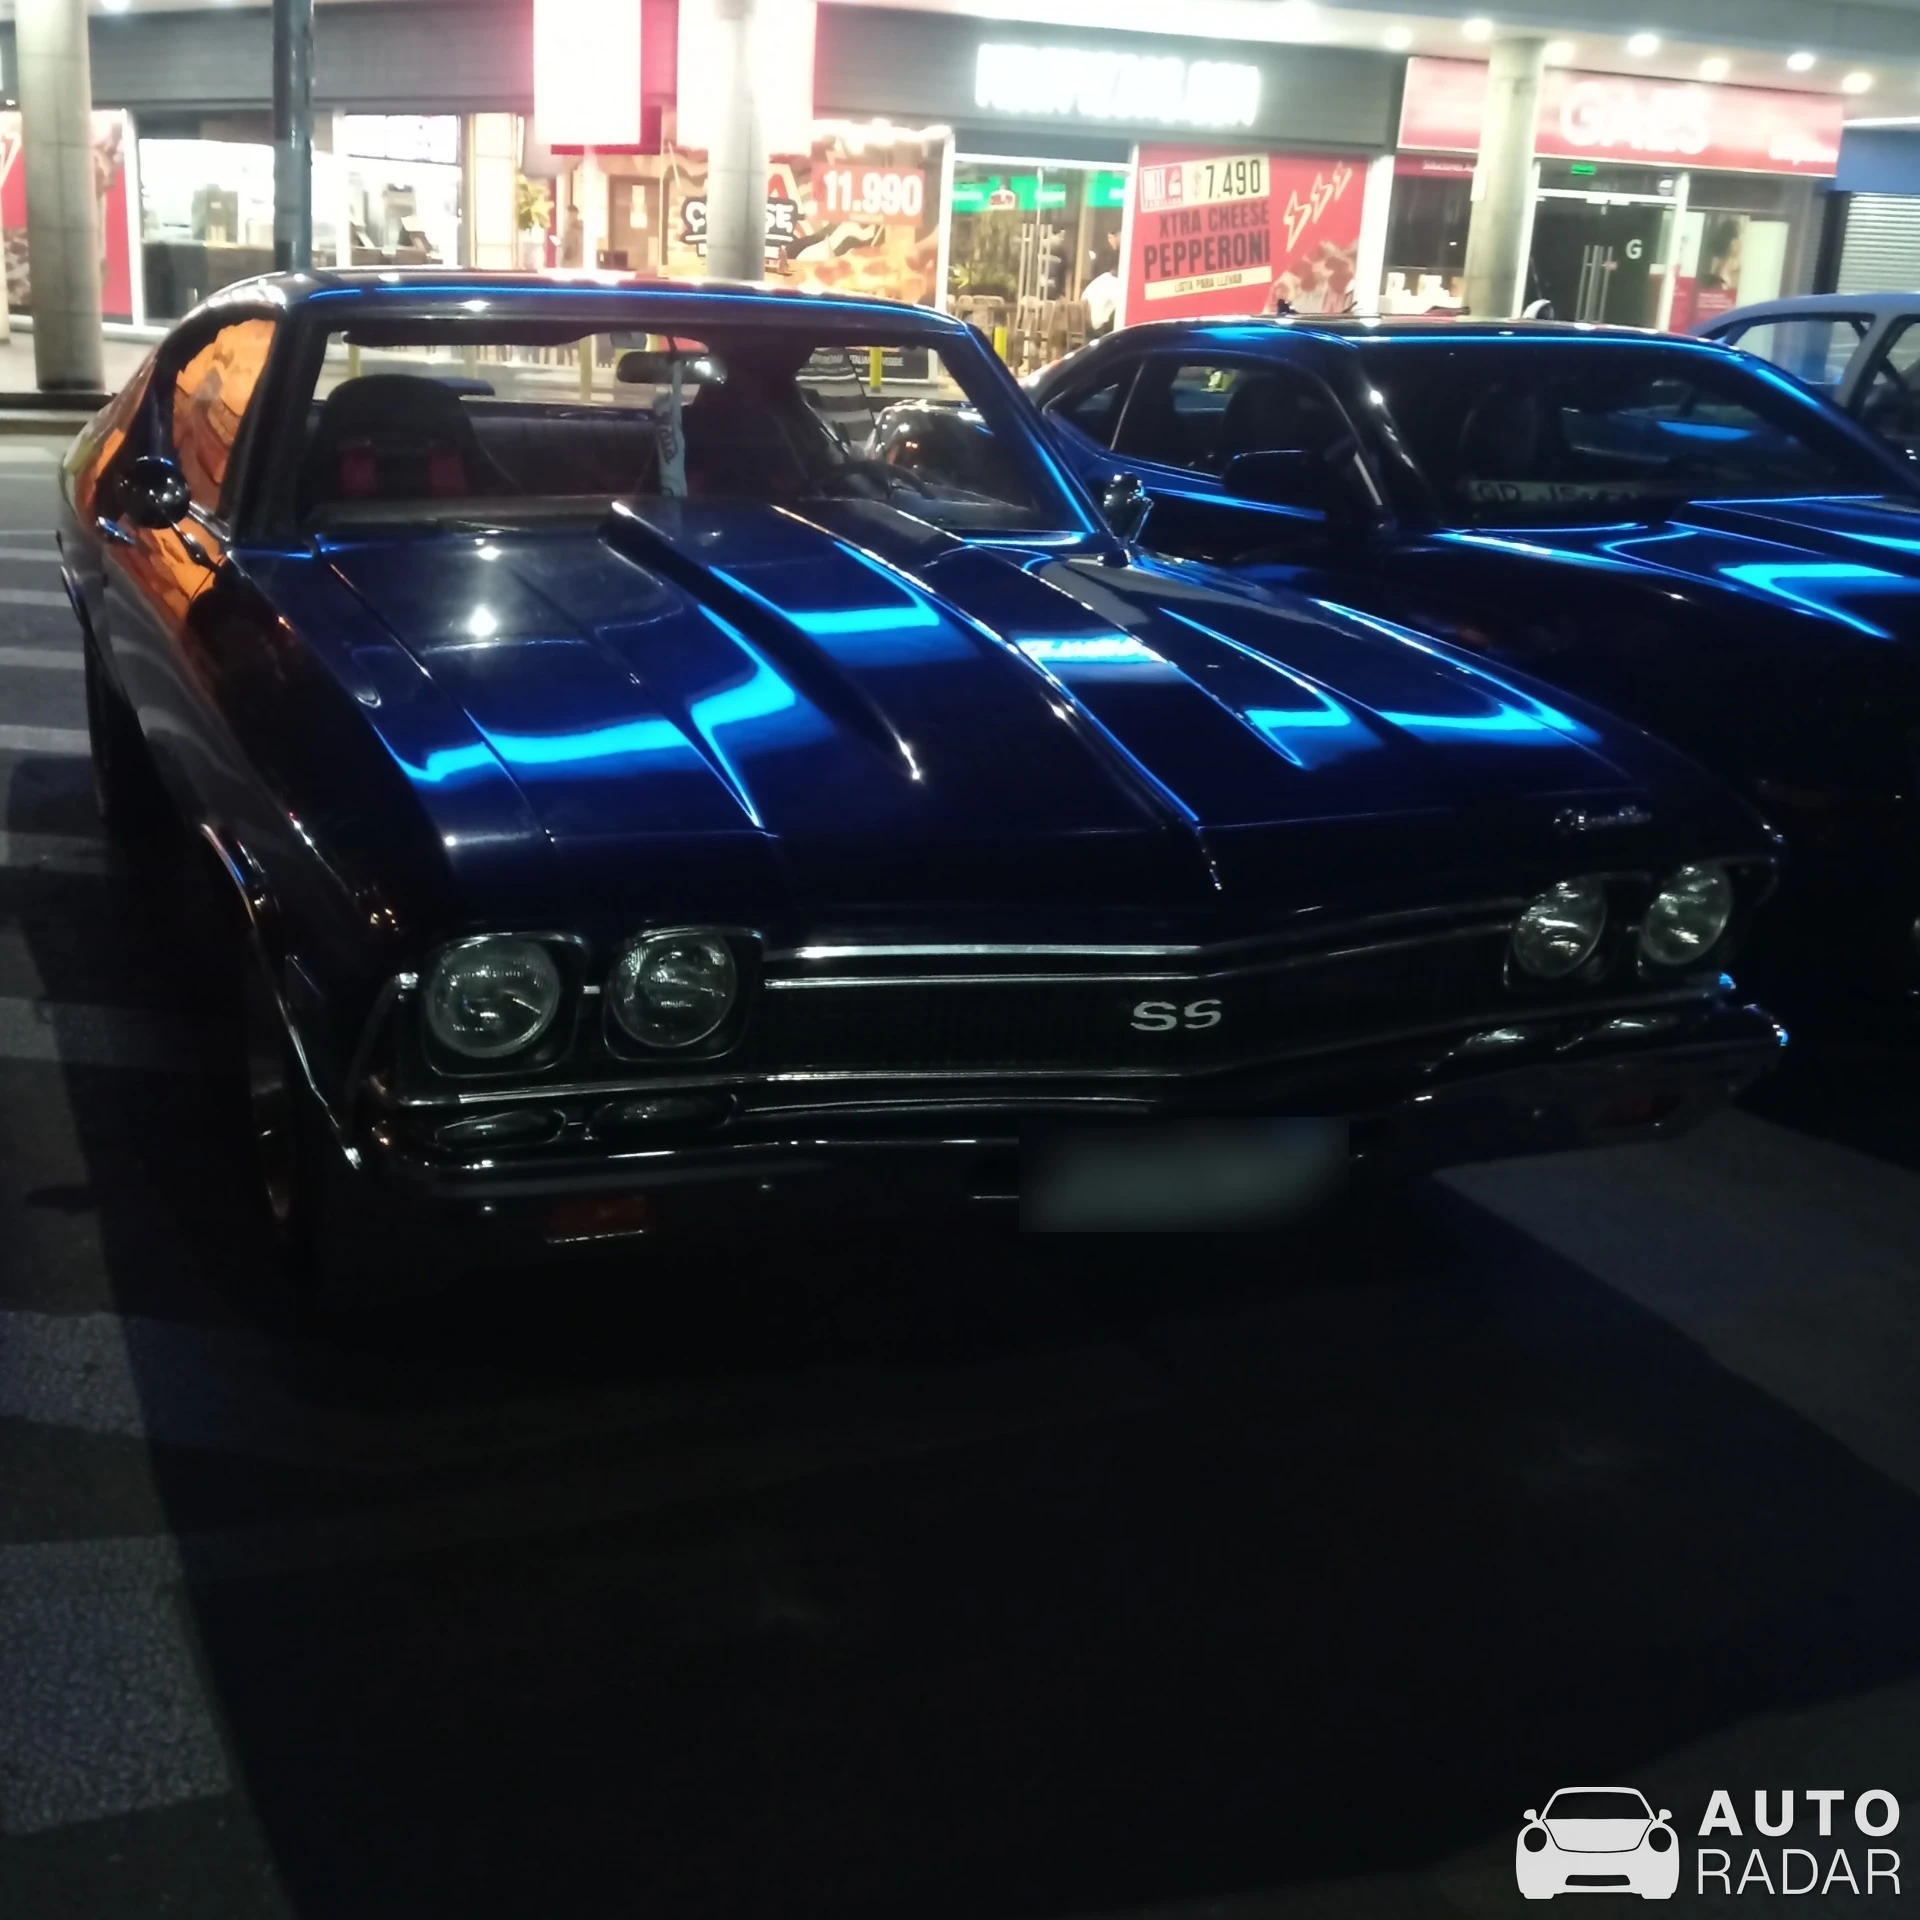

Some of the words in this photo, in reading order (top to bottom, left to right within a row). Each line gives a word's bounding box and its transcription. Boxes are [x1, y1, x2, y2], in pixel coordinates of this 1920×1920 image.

[823, 169, 924, 217] 11.990
[1159, 208, 1202, 239] XTRA
[1208, 200, 1269, 232] CHEESE
[1143, 229, 1271, 280] PEPPERONI
[1625, 239, 1643, 260] G
[1130, 998, 1222, 1031] SS
